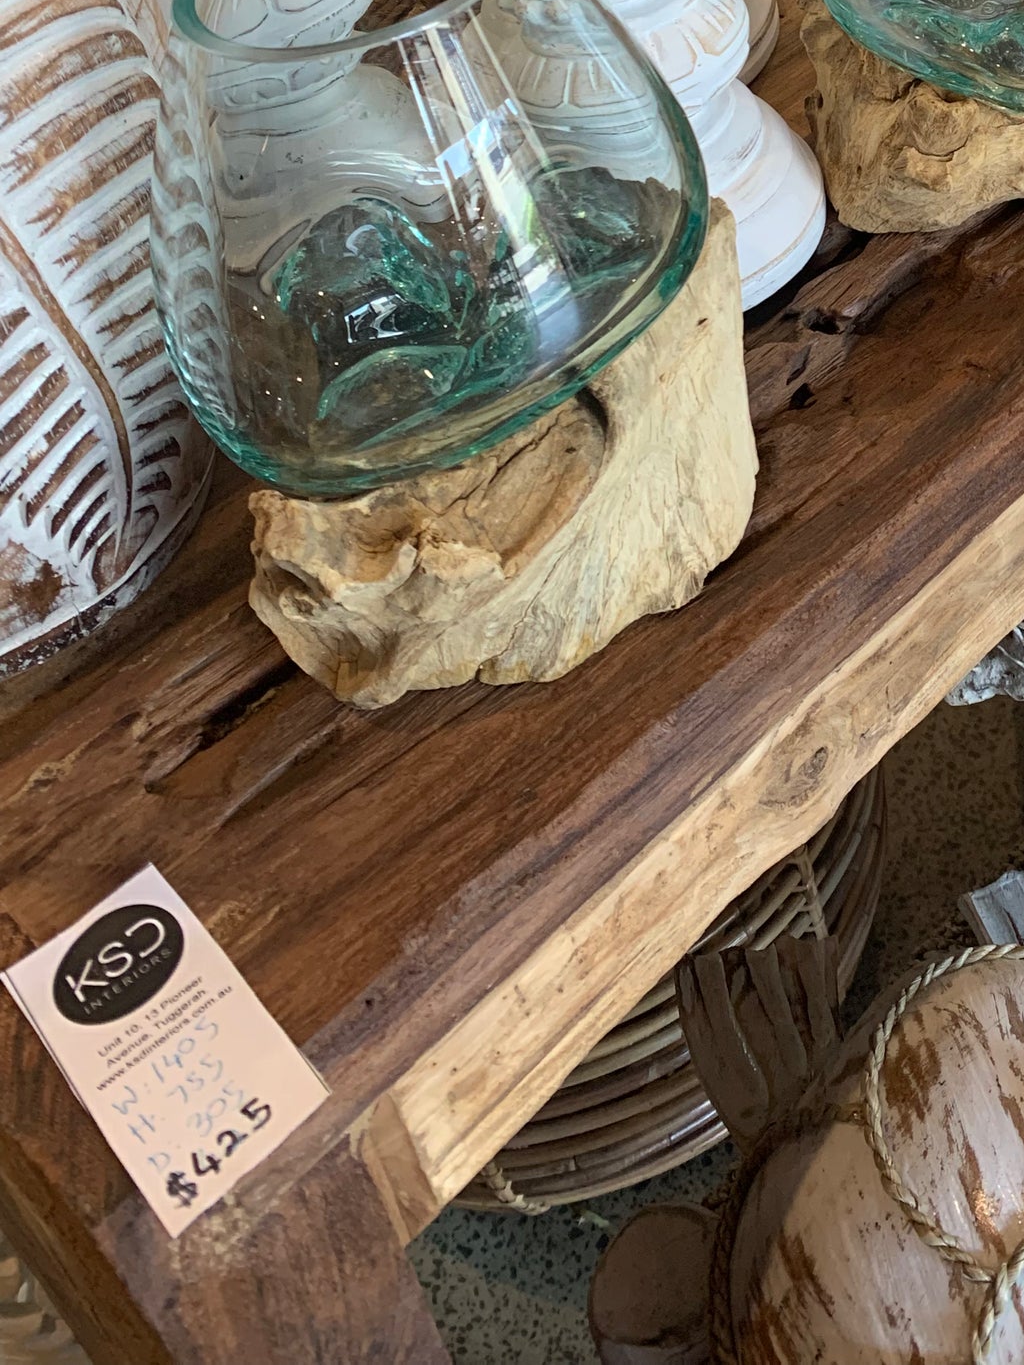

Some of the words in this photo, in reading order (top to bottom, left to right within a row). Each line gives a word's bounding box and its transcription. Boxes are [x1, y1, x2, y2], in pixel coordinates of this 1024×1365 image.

[65, 918, 166, 1003] KSD
[84, 947, 172, 1015] INTERIORS
[97, 1036, 123, 1057] Unit
[144, 1008, 159, 1021] 13
[160, 975, 203, 1010] Pioneer
[151, 1018, 219, 1084] 1405
[166, 1096, 272, 1210] $425
